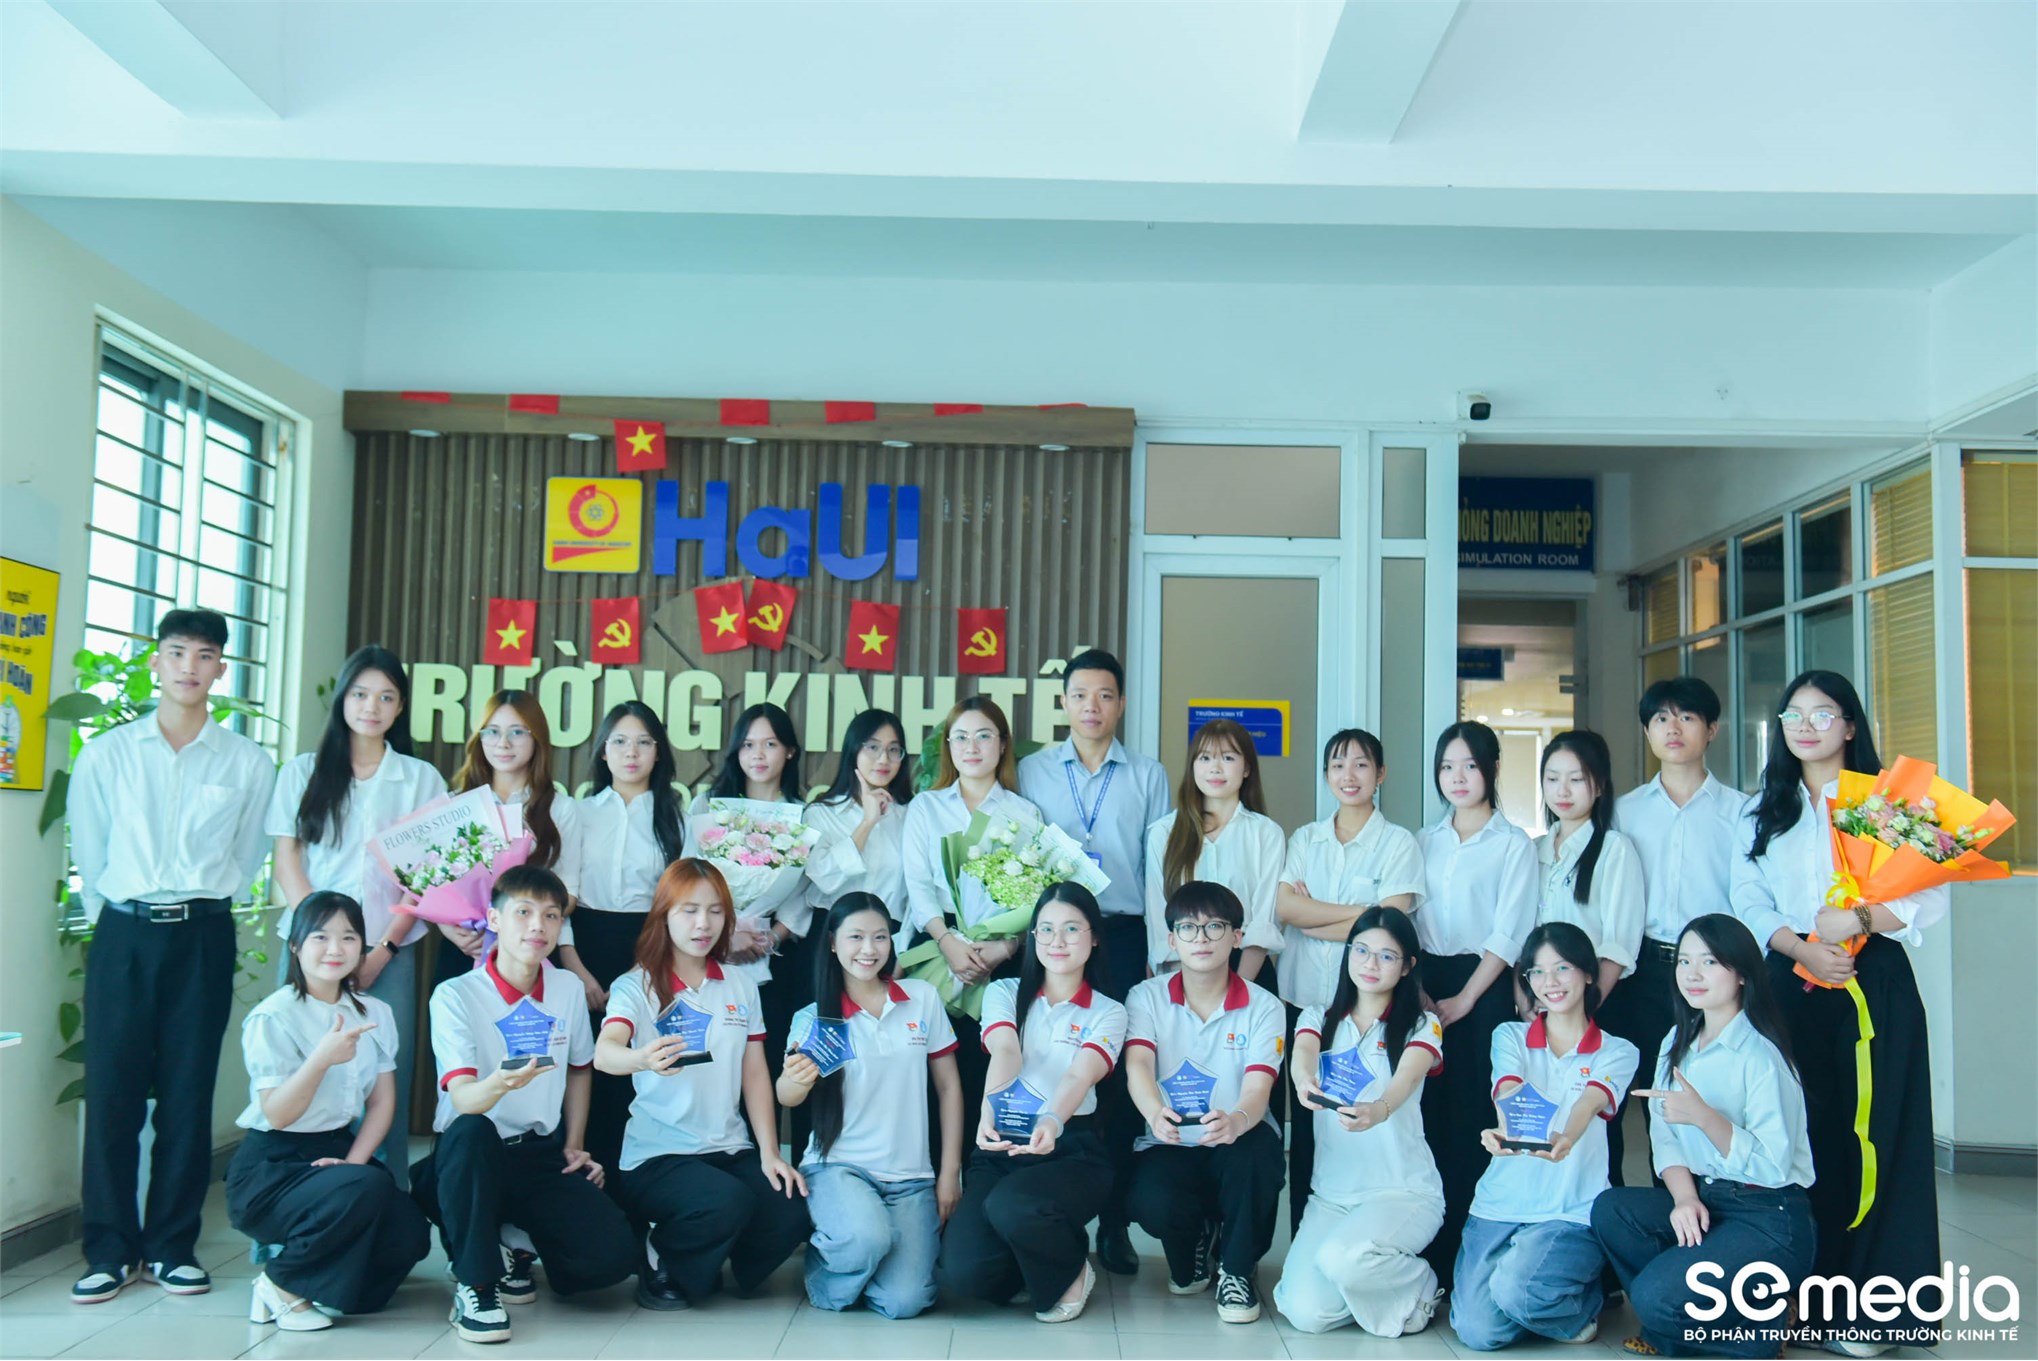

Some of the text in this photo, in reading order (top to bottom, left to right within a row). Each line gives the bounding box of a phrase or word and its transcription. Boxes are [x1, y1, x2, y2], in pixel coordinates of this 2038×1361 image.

[654, 480, 920, 581] HaUI
[1493, 509, 1539, 544] DOANH
[1543, 504, 1592, 549] NGHIỆP
[1538, 553, 1579, 566] ROOM
[402, 639, 723, 751] RƯỜNG
[383, 804, 472, 851] FLOWERS STUDIO
